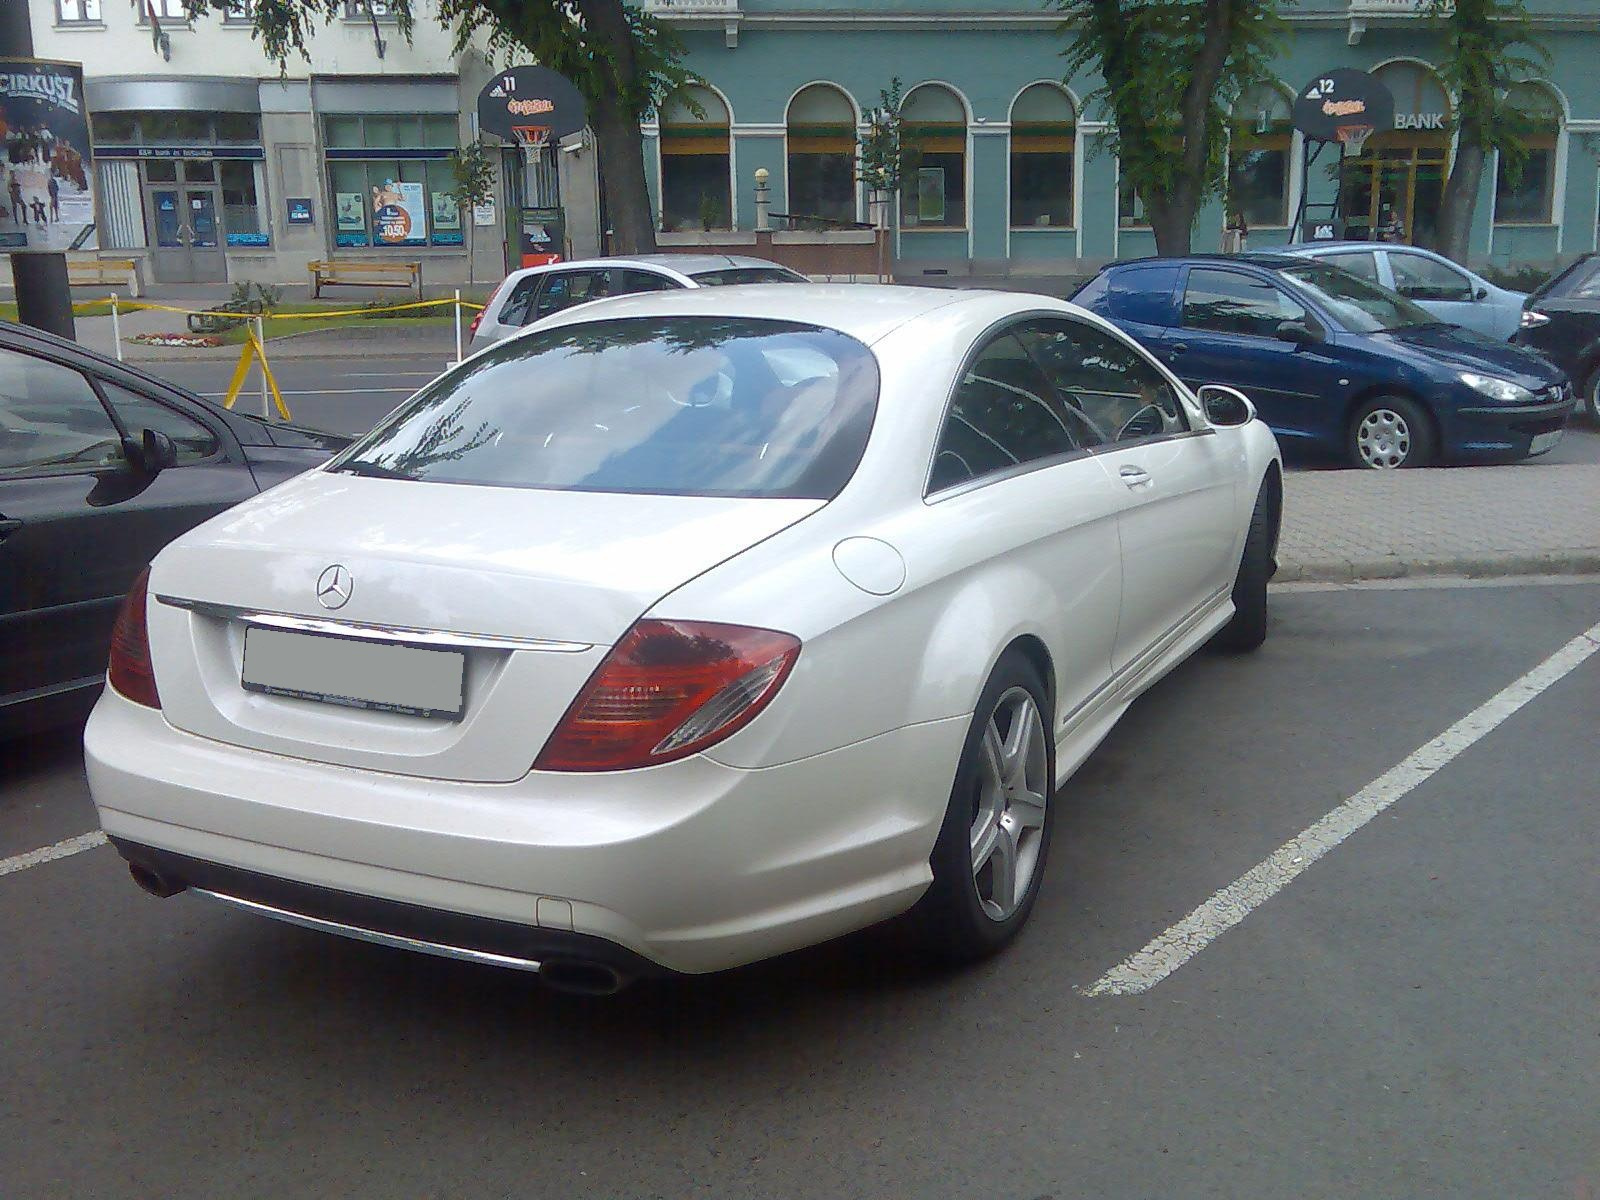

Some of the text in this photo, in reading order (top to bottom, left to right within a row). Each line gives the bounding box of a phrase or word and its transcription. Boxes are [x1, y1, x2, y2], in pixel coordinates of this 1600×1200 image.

[503, 76, 516, 91] 11
[1318, 78, 1335, 93] 12
[1394, 113, 1444, 129] BANK
